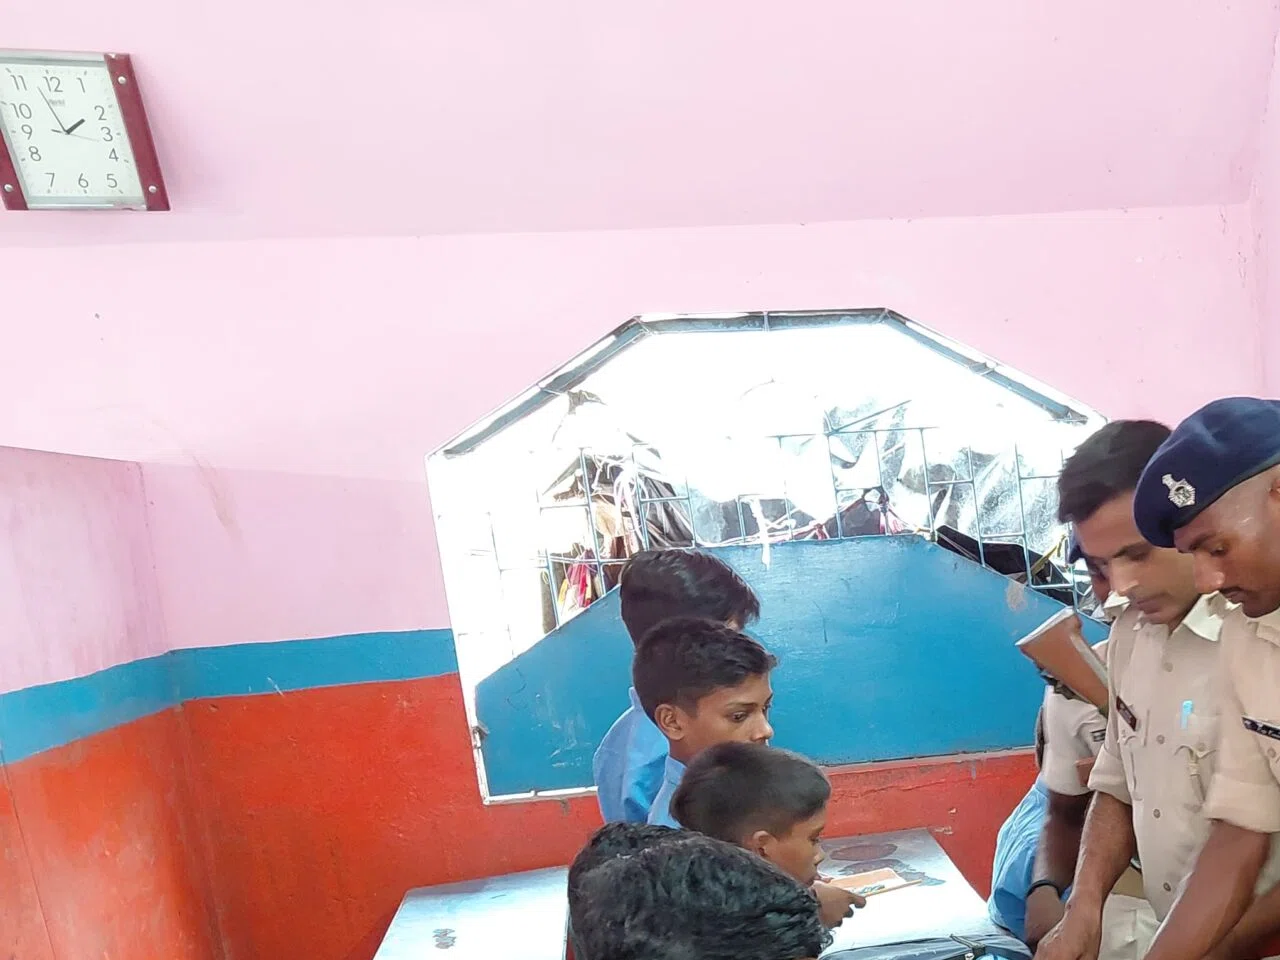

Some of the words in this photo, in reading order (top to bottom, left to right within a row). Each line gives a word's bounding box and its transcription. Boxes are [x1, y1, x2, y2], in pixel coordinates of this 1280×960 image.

[10, 75, 27, 91] 11
[43, 76, 63, 93] 12
[77, 77, 86, 93] 1
[11, 103, 32, 119] 10
[94, 105, 107, 121] 2
[21, 124, 33, 140] 9
[100, 126, 113, 142] 3
[28, 146, 42, 161] 8
[108, 148, 119, 162] 4
[45, 172, 55, 187] 7
[78, 173, 89, 188] 6
[106, 173, 118, 188] 5
